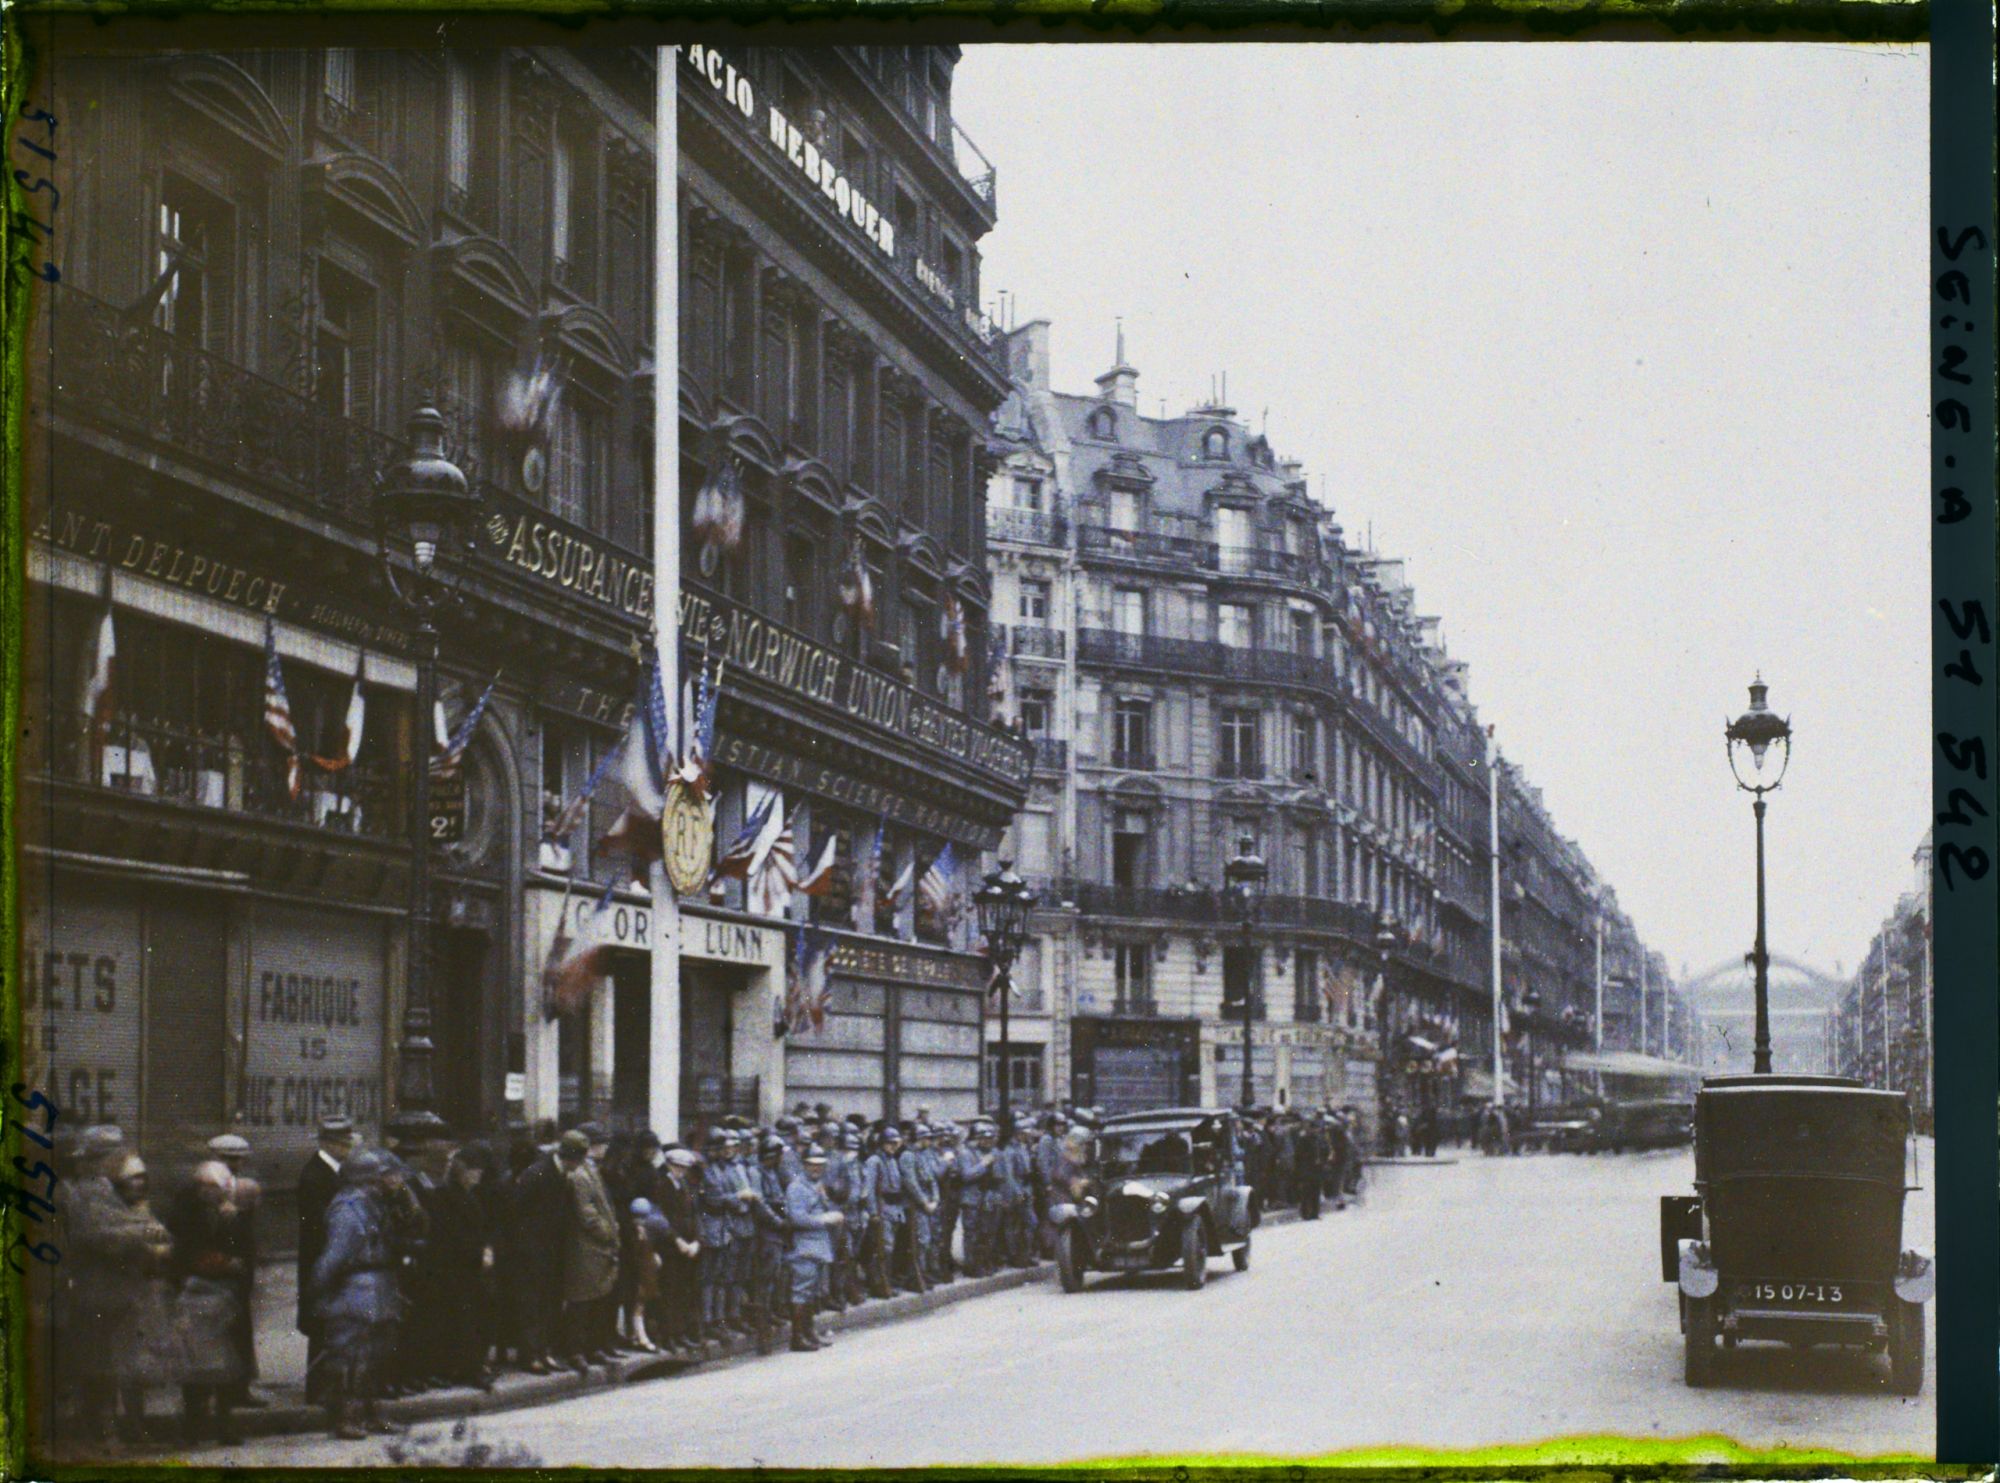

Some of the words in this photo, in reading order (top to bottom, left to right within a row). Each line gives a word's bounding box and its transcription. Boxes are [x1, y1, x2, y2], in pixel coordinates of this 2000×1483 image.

[674, 44, 754, 118] ACIO
[121, 534, 286, 613] DELPUECH
[506, 514, 658, 632] ASSURANCE
[723, 608, 840, 704] NORWICH
[848, 665, 913, 734] UNION
[576, 687, 637, 728] THE
[706, 921, 763, 961] LUNN
[261, 970, 360, 1028] FABRIQUE
